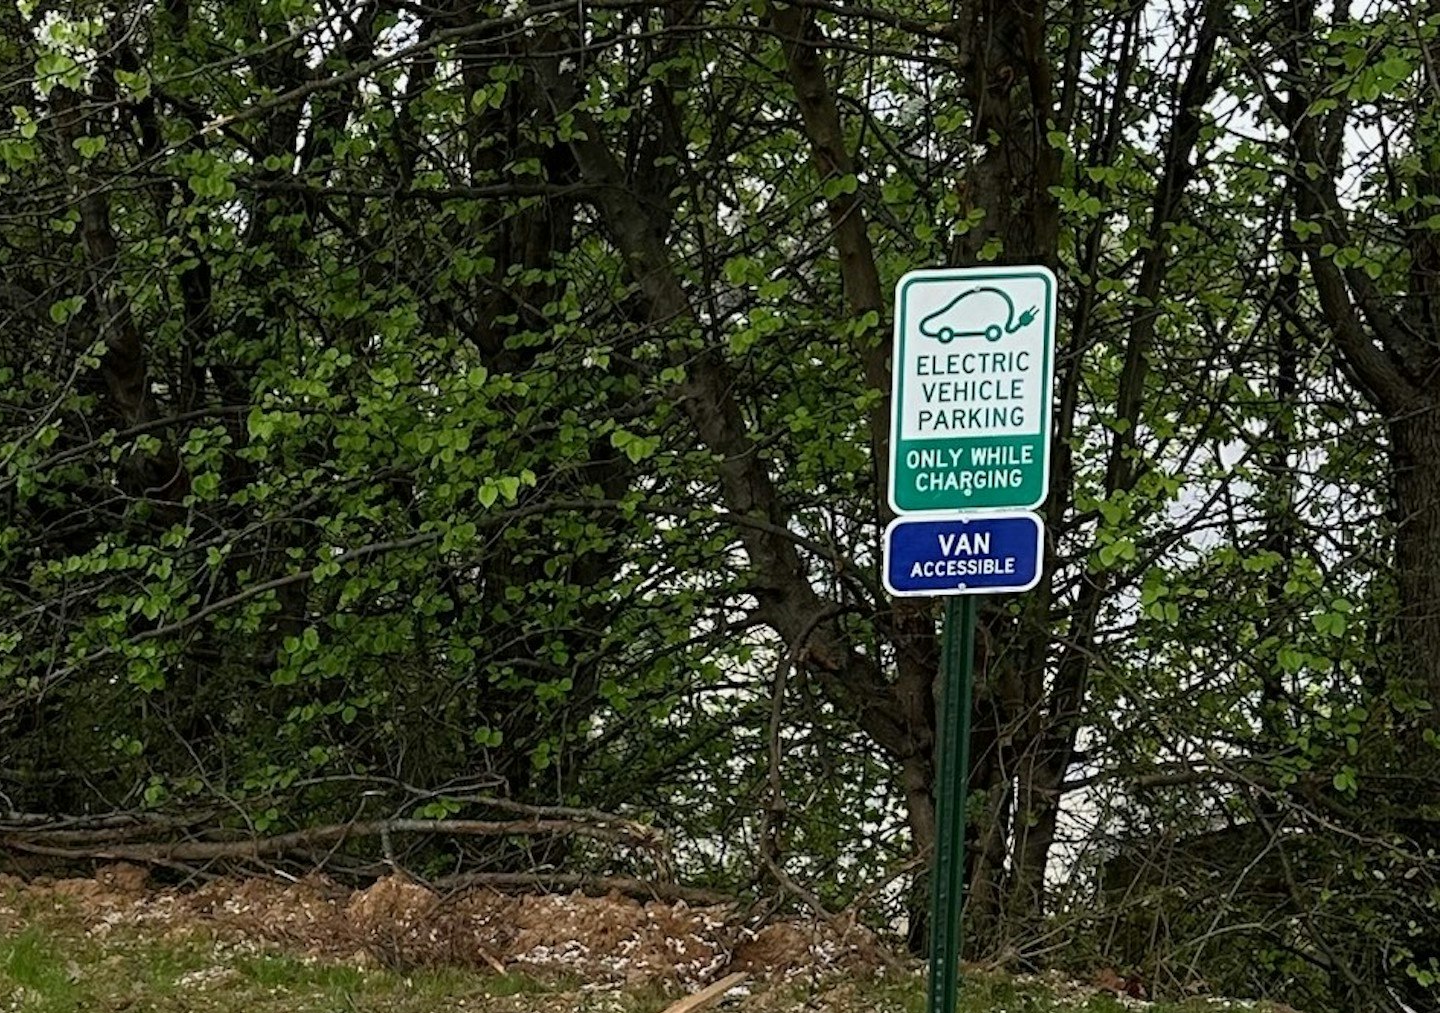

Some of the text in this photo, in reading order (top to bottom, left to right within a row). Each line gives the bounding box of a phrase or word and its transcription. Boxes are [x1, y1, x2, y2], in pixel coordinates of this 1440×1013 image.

[916, 351, 1029, 376] ELECTRIC
[922, 379, 1024, 403] VEHICLE
[918, 407, 1024, 431] PARKING
[906, 445, 1033, 469] ONLY WHILE
[915, 469, 1022, 492] CHARGING
[938, 532, 990, 556] VAN
[910, 558, 1015, 578] ACCESSIBLE
